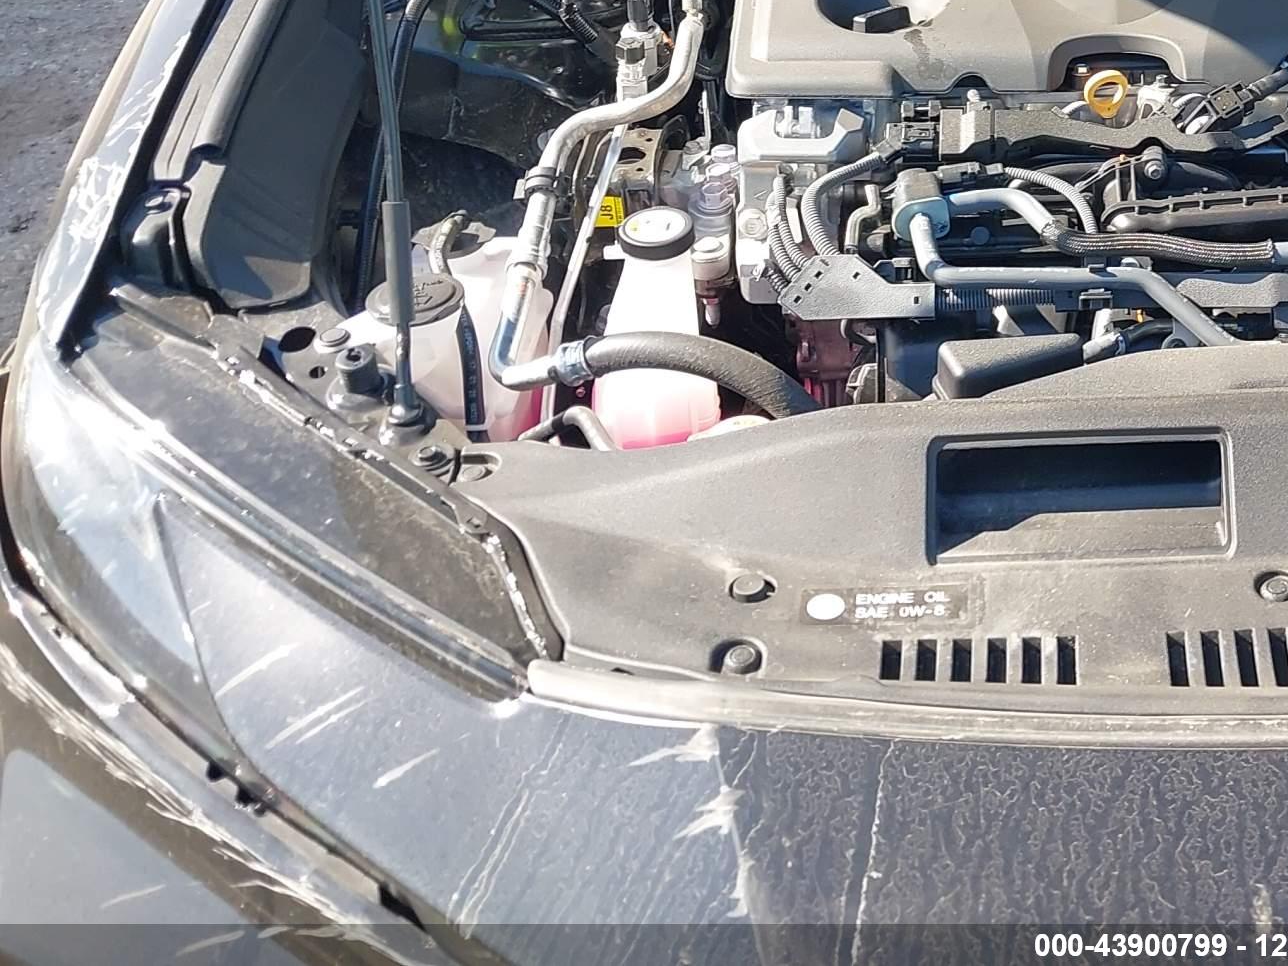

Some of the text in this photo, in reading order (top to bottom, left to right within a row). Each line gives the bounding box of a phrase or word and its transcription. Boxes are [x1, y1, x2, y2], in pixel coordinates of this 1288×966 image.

[855, 591, 951, 605] ENGINE OIL
[855, 606, 889, 619] SAE
